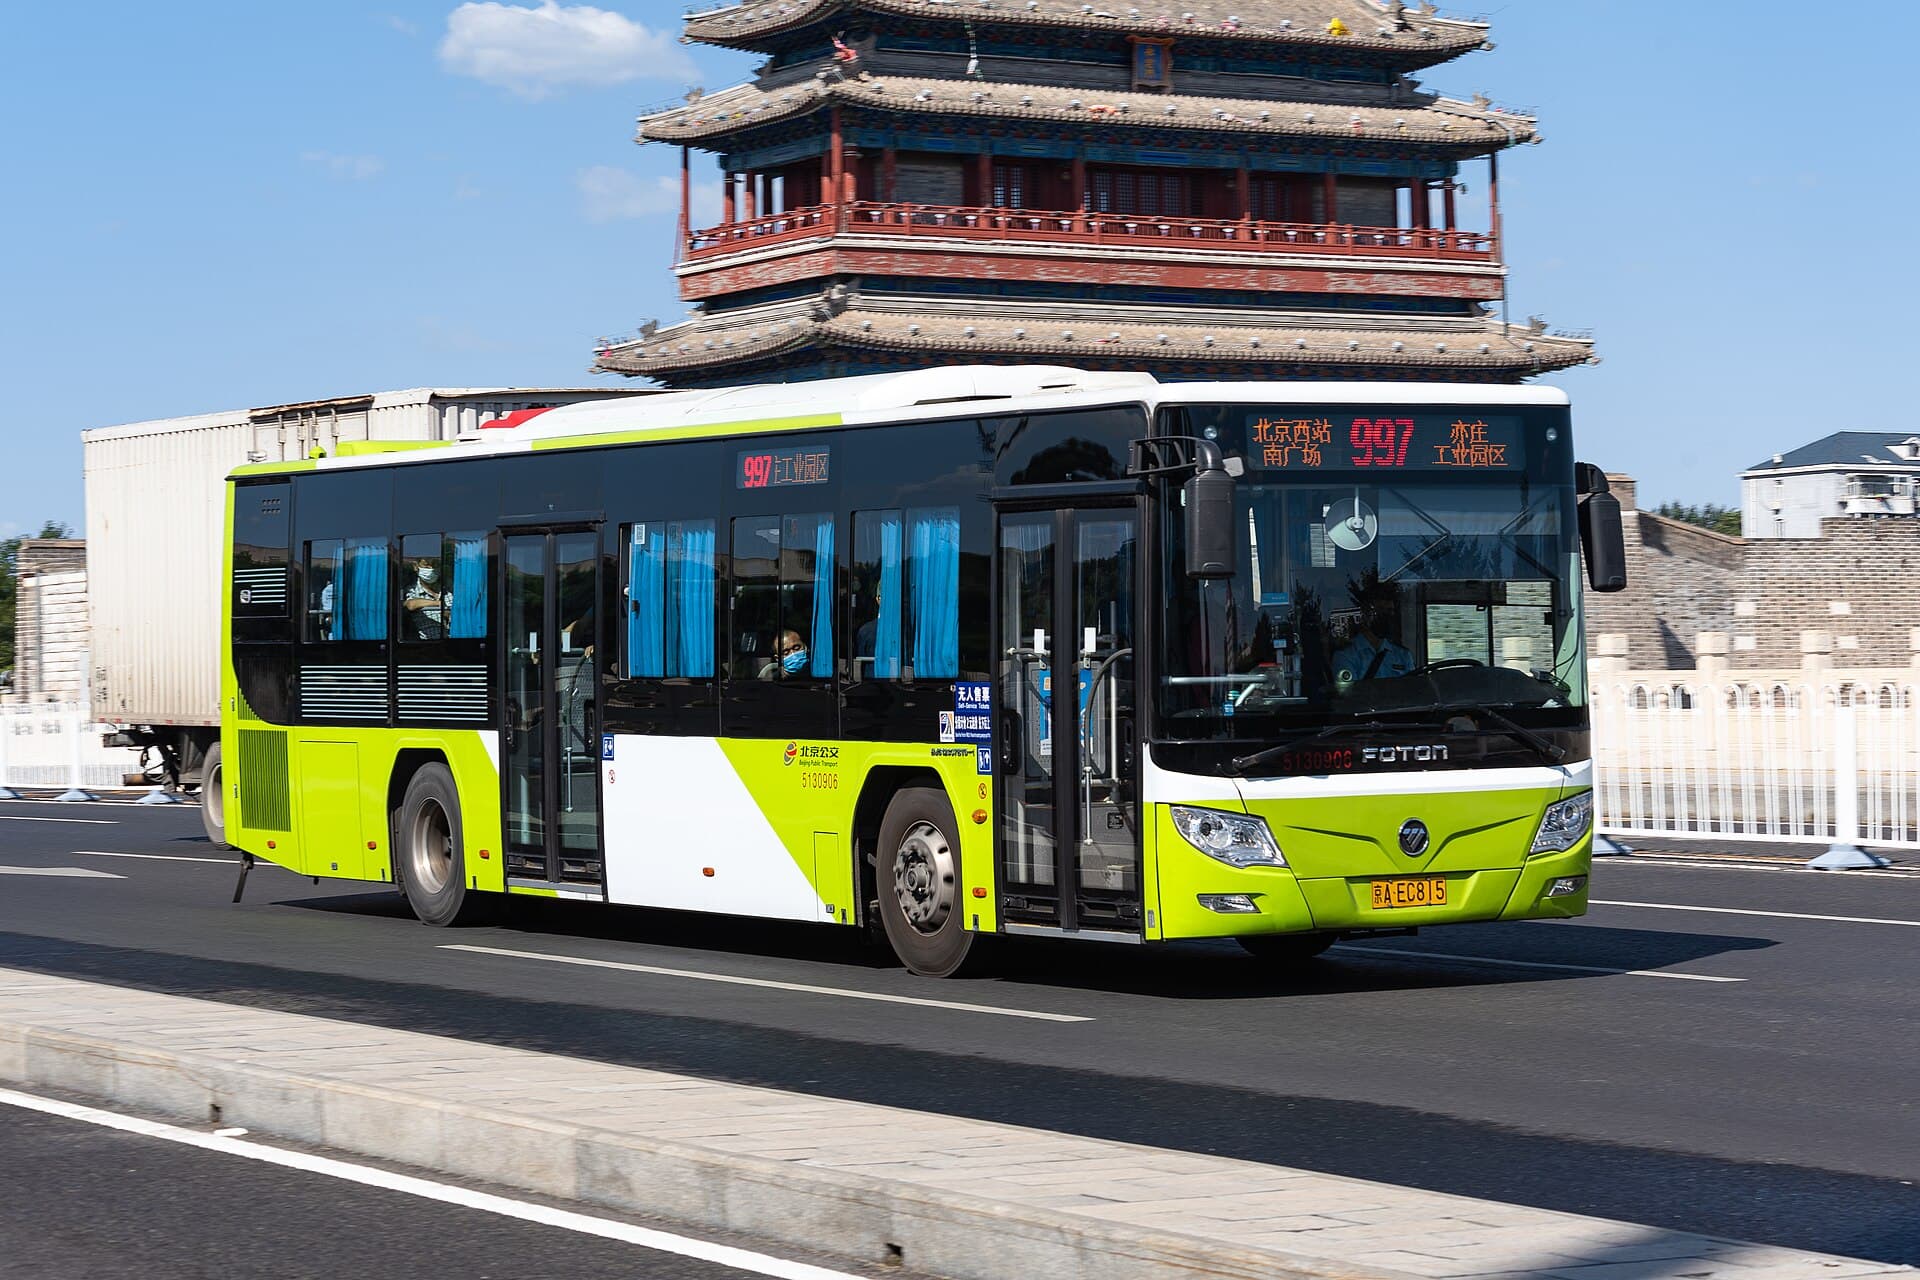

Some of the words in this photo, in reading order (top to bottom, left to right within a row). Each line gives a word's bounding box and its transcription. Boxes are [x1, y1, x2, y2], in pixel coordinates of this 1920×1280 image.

[1253, 418, 1333, 443] 北京西站
[1350, 417, 1415, 467] 997
[1450, 419, 1489, 444] 亦庄
[1263, 443, 1322, 467] 南广场
[1431, 444, 1508, 467] 工业园区
[743, 455, 772, 488] 997
[958, 686, 990, 702] 无人售票
[800, 745, 839, 758] 北京公交
[1361, 744, 1449, 764] FOTON
[802, 772, 838, 789] 5130906
